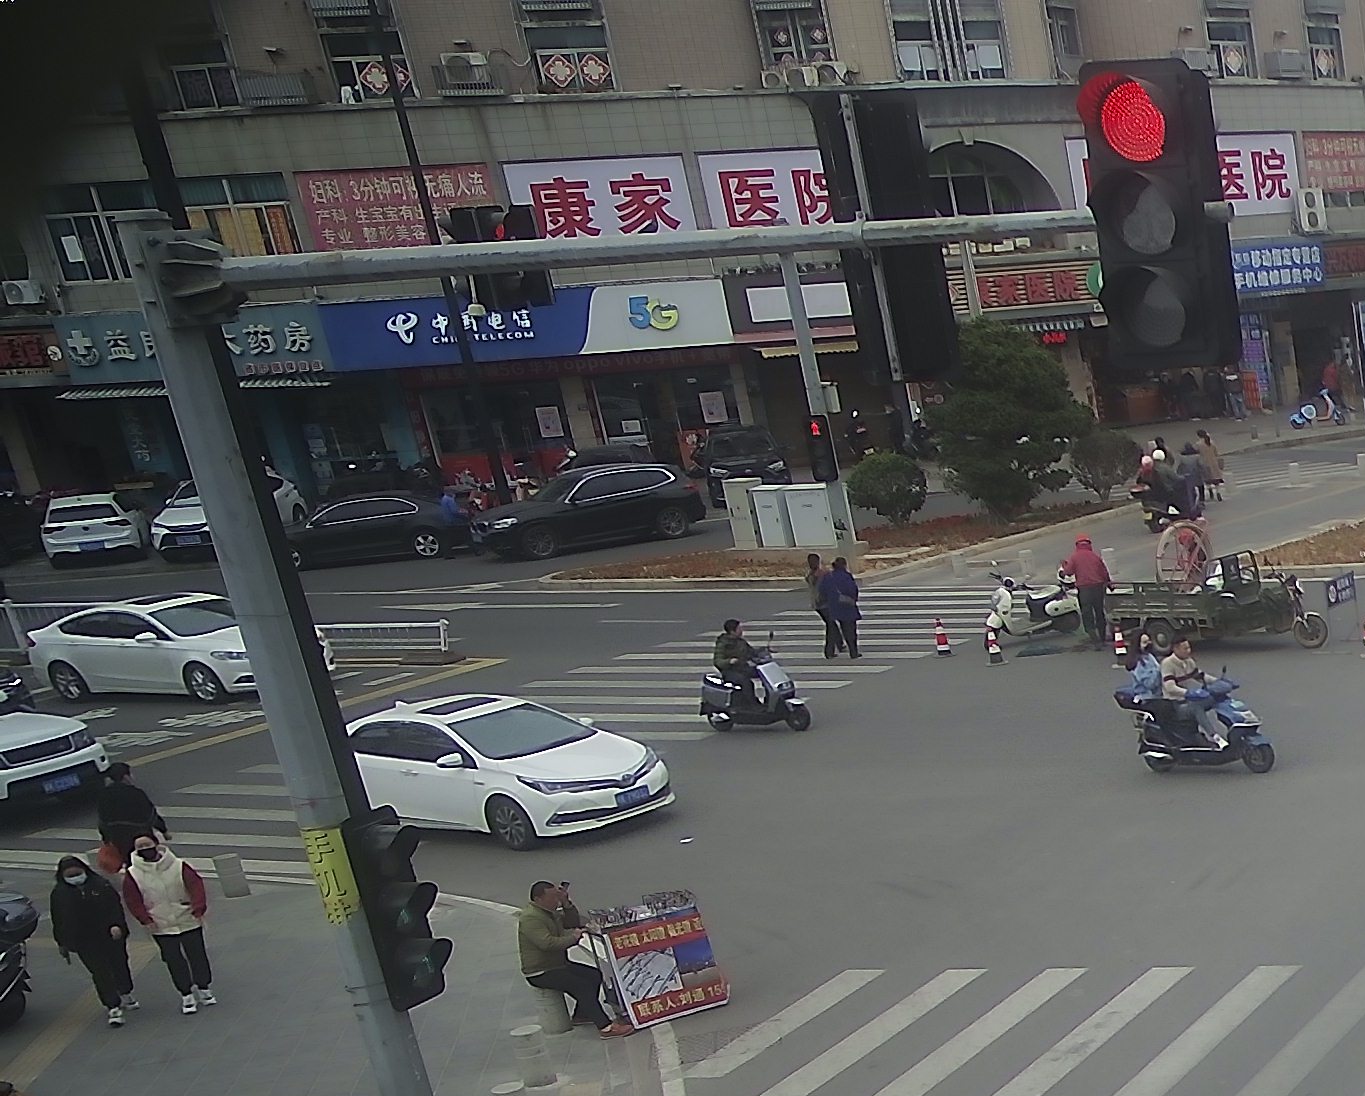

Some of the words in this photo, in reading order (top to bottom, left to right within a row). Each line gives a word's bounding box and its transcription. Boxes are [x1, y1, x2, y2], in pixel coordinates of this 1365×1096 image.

[1218, 148, 1291, 201] 医院
[529, 174, 682, 238] 康家
[321, 228, 353, 244] 专业
[431, 309, 532, 336] 中国电信
[628, 295, 680, 331] 5G
[473, 331, 535, 341] TELECOM
